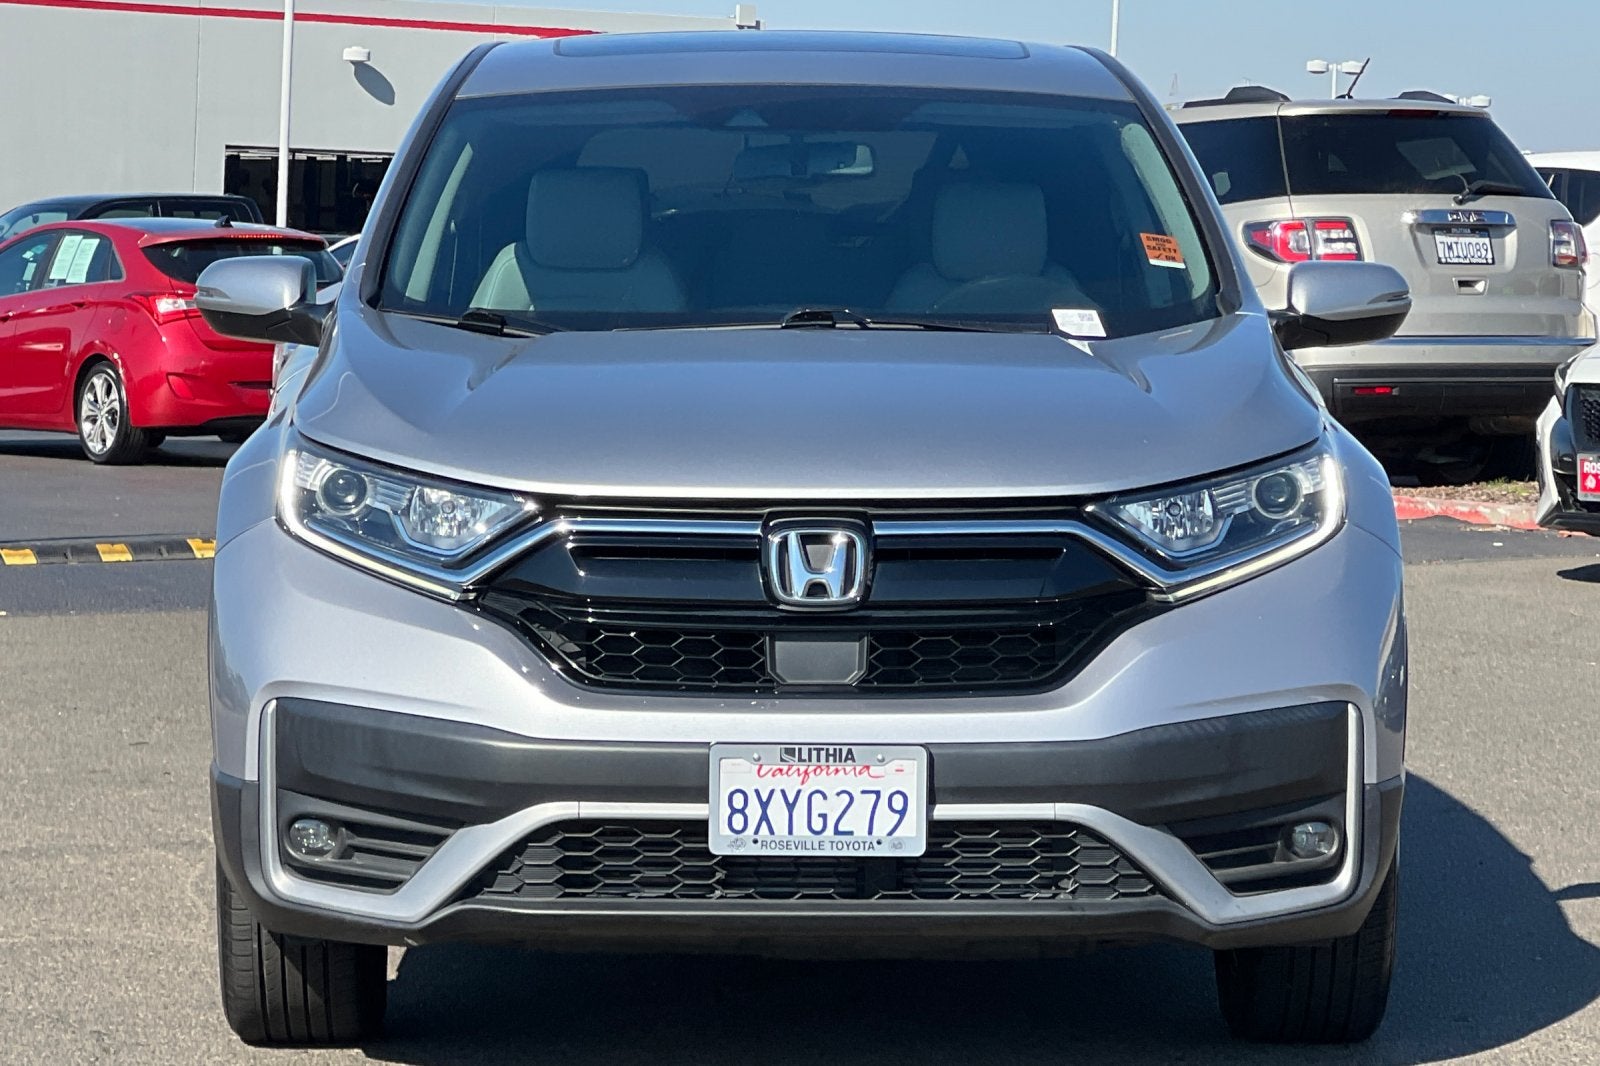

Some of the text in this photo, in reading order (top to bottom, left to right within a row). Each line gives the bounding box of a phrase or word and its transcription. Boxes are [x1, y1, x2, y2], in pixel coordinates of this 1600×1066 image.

[1439, 241, 1489, 259] 7MIU089
[797, 747, 857, 763] LITHIA
[756, 764, 885, 785] California
[727, 788, 909, 836] 8XYG279
[760, 839, 876, 851] ROSEVILLE TOYOTA
